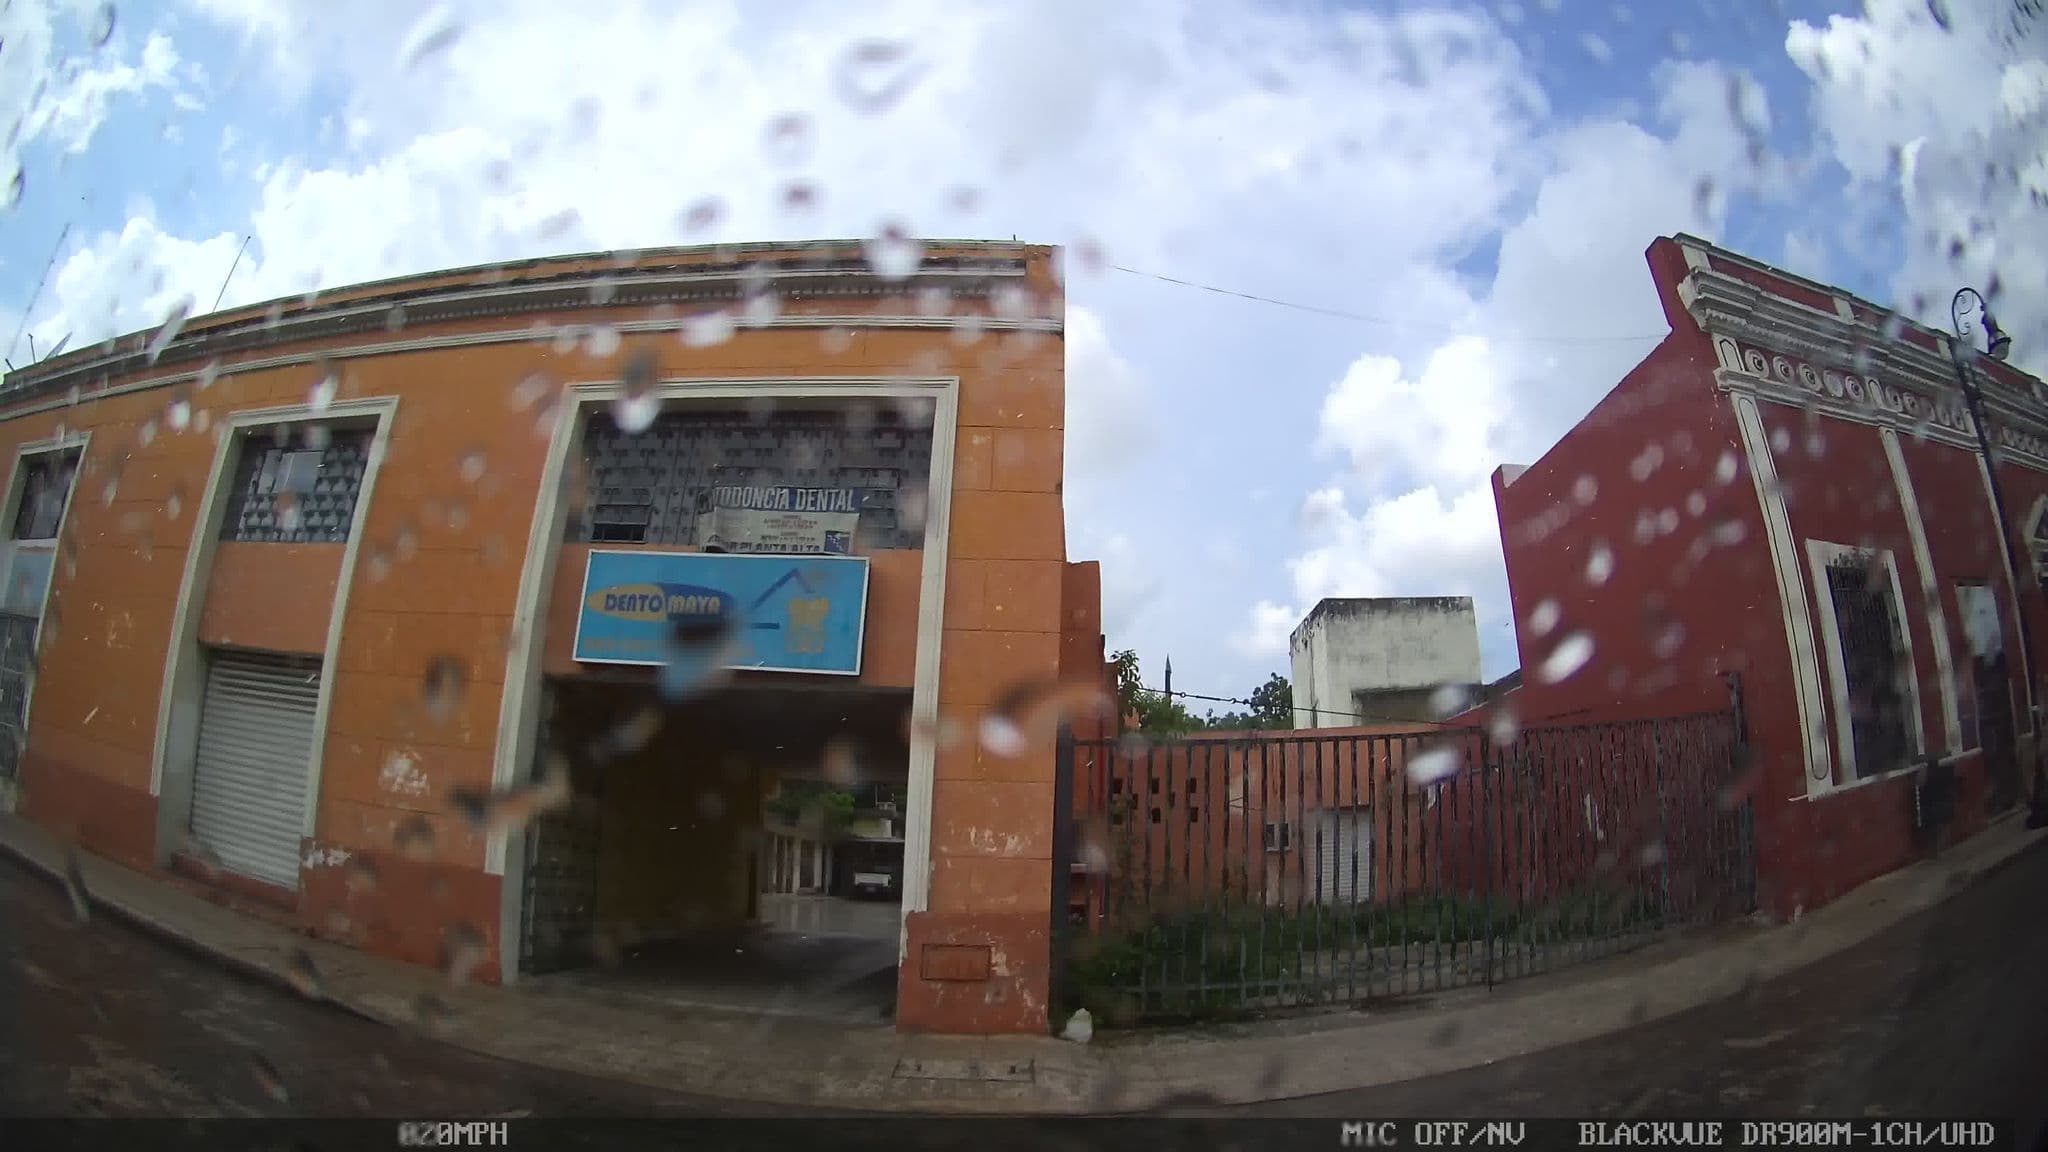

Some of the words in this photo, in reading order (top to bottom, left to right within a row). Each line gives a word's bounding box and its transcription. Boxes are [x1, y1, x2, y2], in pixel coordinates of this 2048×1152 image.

[796, 489, 855, 511] DENTAL
[604, 593, 663, 613] DENTO
[667, 595, 721, 615] MAYA
